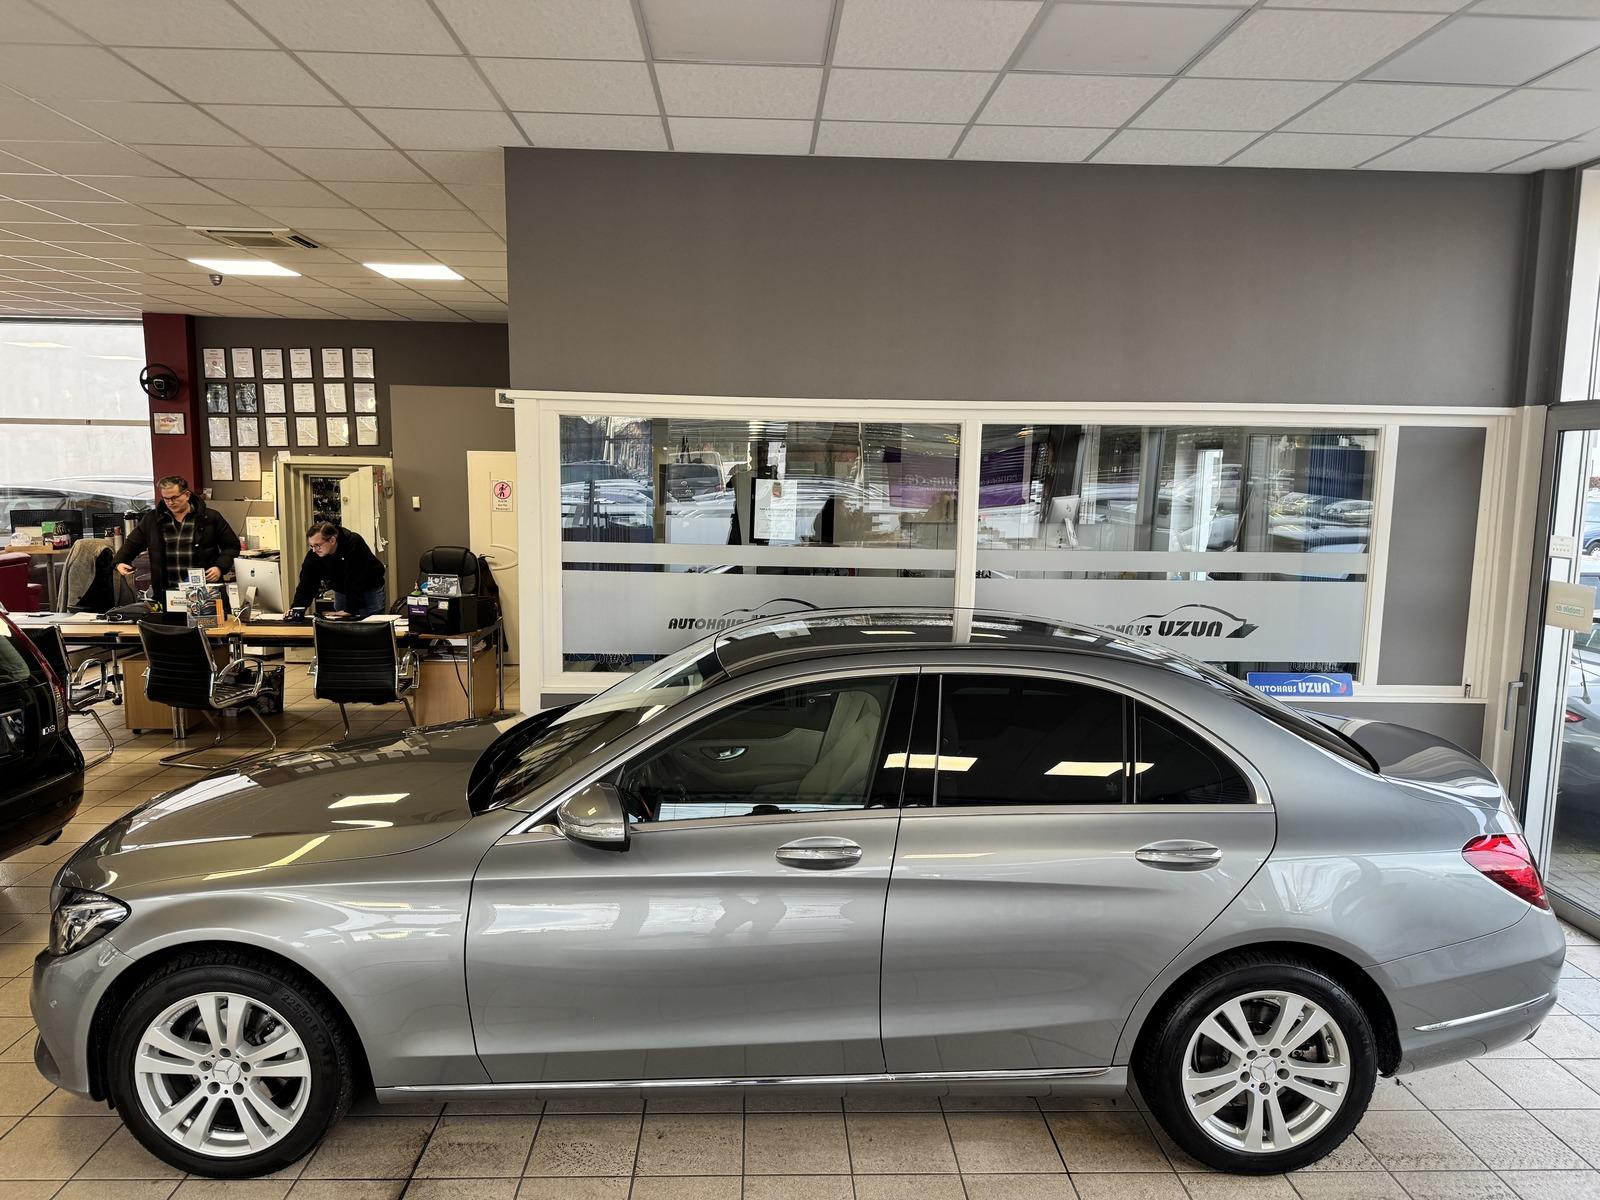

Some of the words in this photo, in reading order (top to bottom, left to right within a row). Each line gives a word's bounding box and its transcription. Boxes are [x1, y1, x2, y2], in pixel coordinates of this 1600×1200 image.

[1094, 623, 1153, 637] HAUS
[1158, 620, 1223, 637] UZUN
[1298, 682, 1331, 693] UZUN
